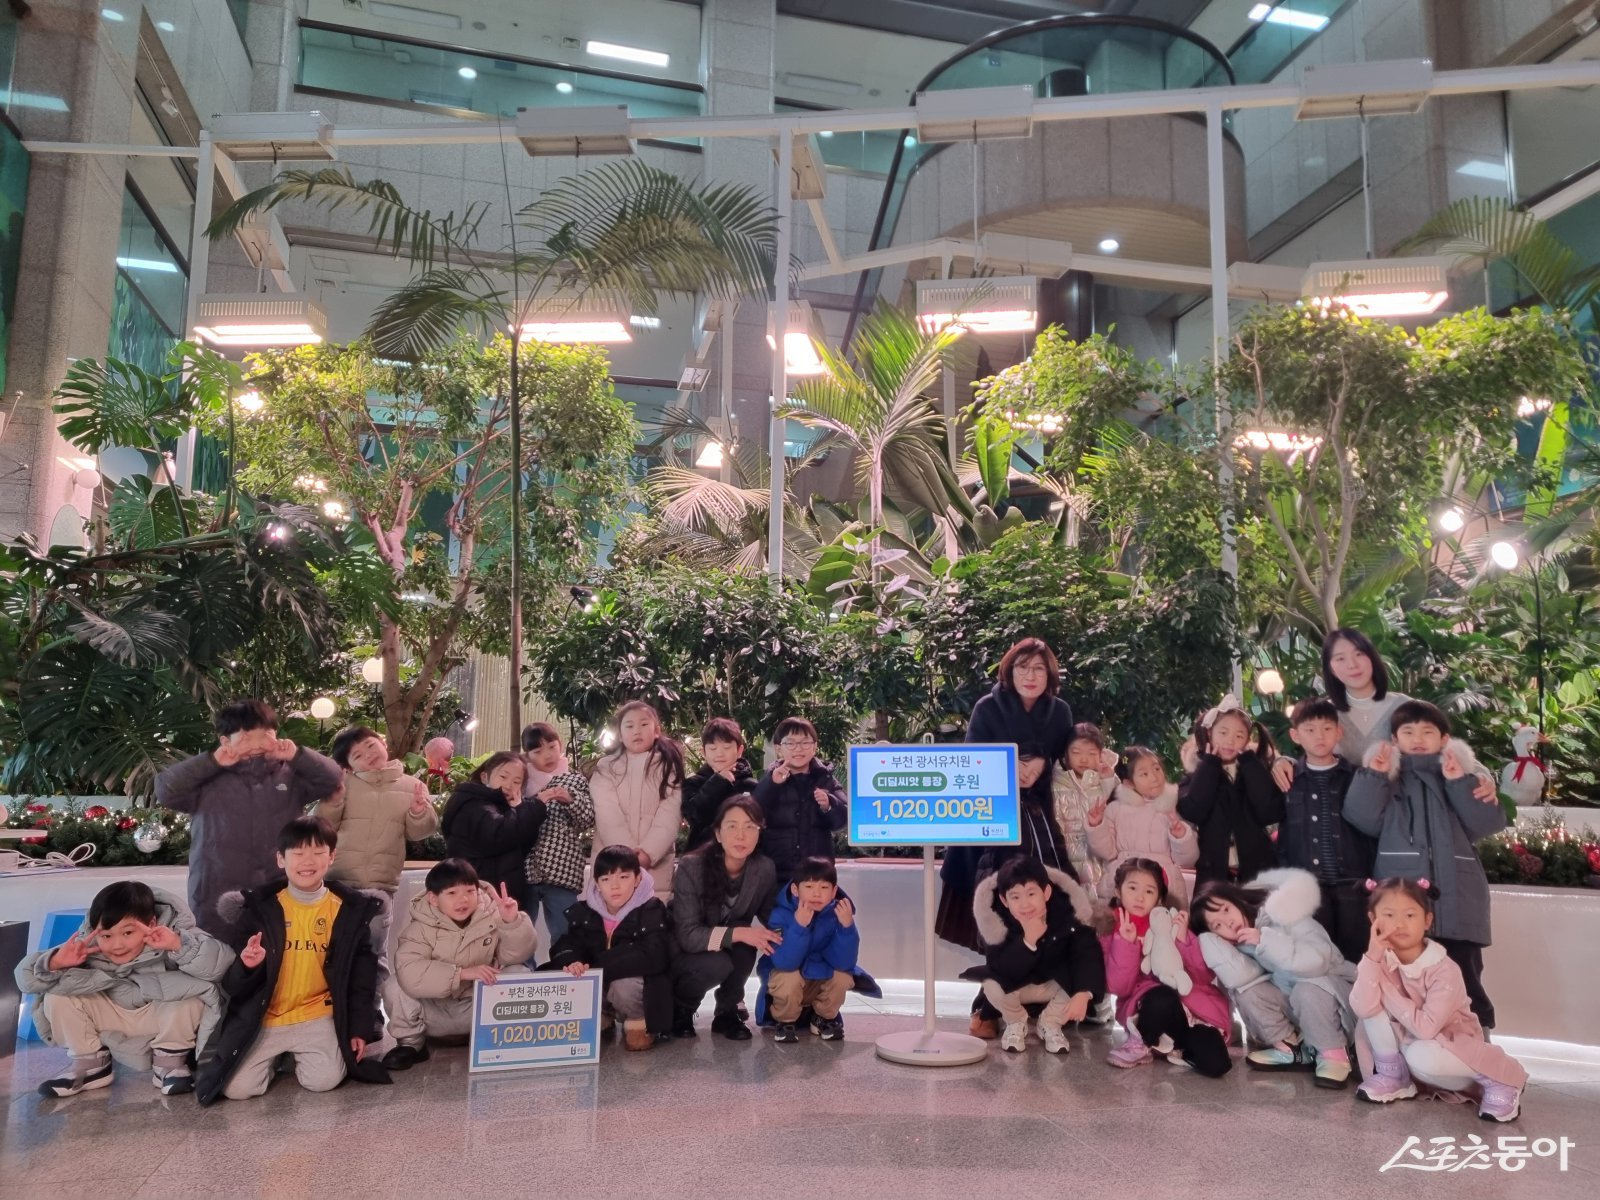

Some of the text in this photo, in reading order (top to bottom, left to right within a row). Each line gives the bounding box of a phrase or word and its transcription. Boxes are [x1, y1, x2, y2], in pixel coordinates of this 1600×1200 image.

[891, 755, 971, 769] 부천 광서유치원
[953, 774, 980, 790] 후원
[872, 797, 993, 822] 1,020,000원
[507, 984, 567, 999] 부천 광서유치원
[552, 1000, 573, 1016] 후원
[491, 1020, 581, 1046] 1,020,000원
